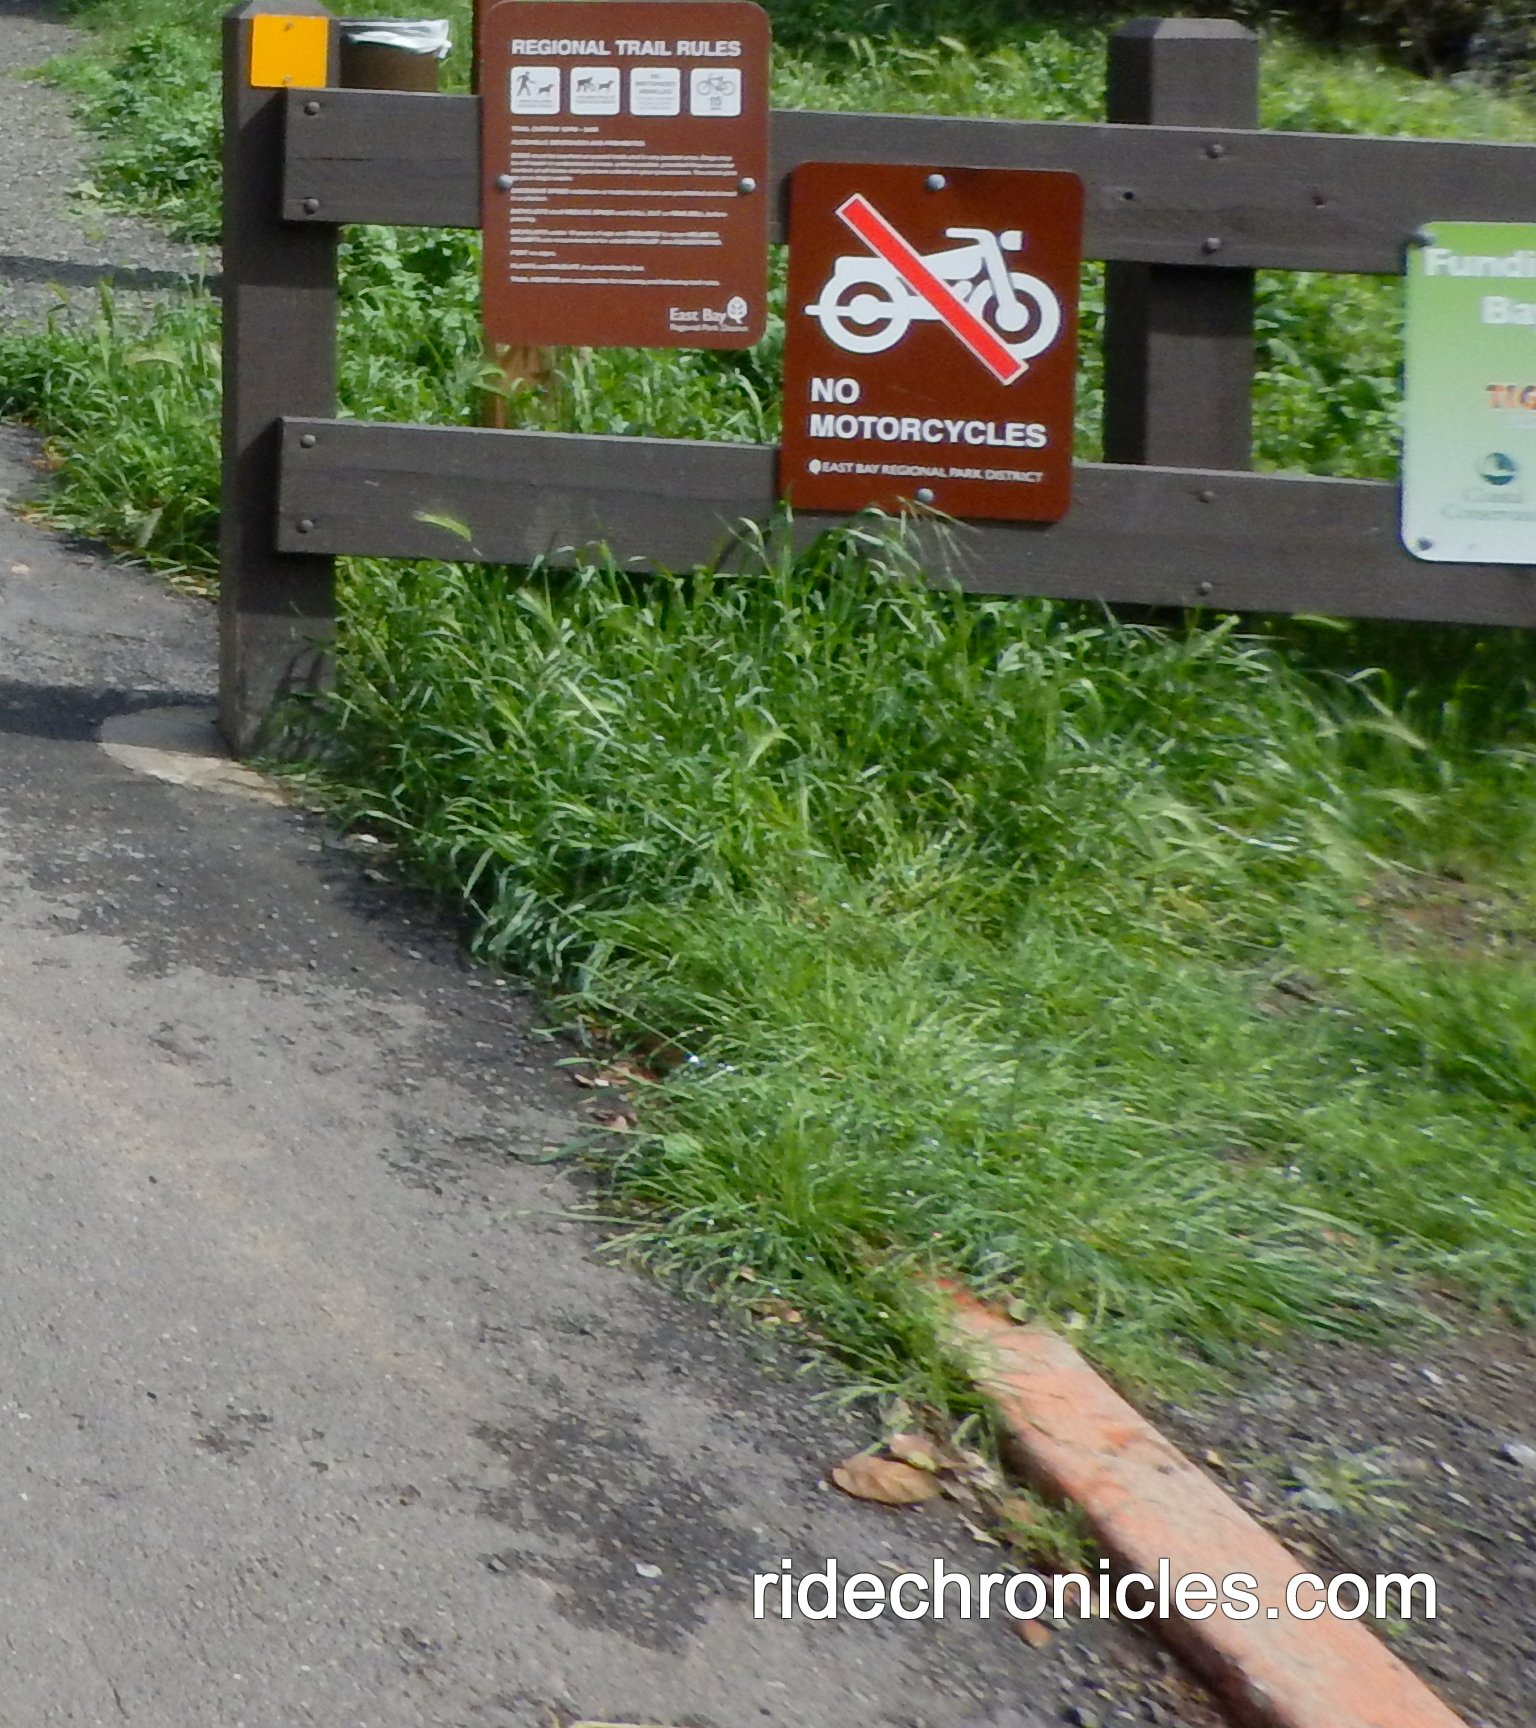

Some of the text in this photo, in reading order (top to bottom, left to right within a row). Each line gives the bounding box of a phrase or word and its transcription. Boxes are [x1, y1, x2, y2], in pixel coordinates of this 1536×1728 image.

[511, 39, 742, 57] REGIONAL TRAIL RULES
[669, 307, 727, 325] East Bay
[810, 377, 860, 404] NO
[809, 413, 1047, 448] MOTORCYCLES
[822, 461, 1043, 482] EAST BAY REGIONAL PARK DISTRICT
